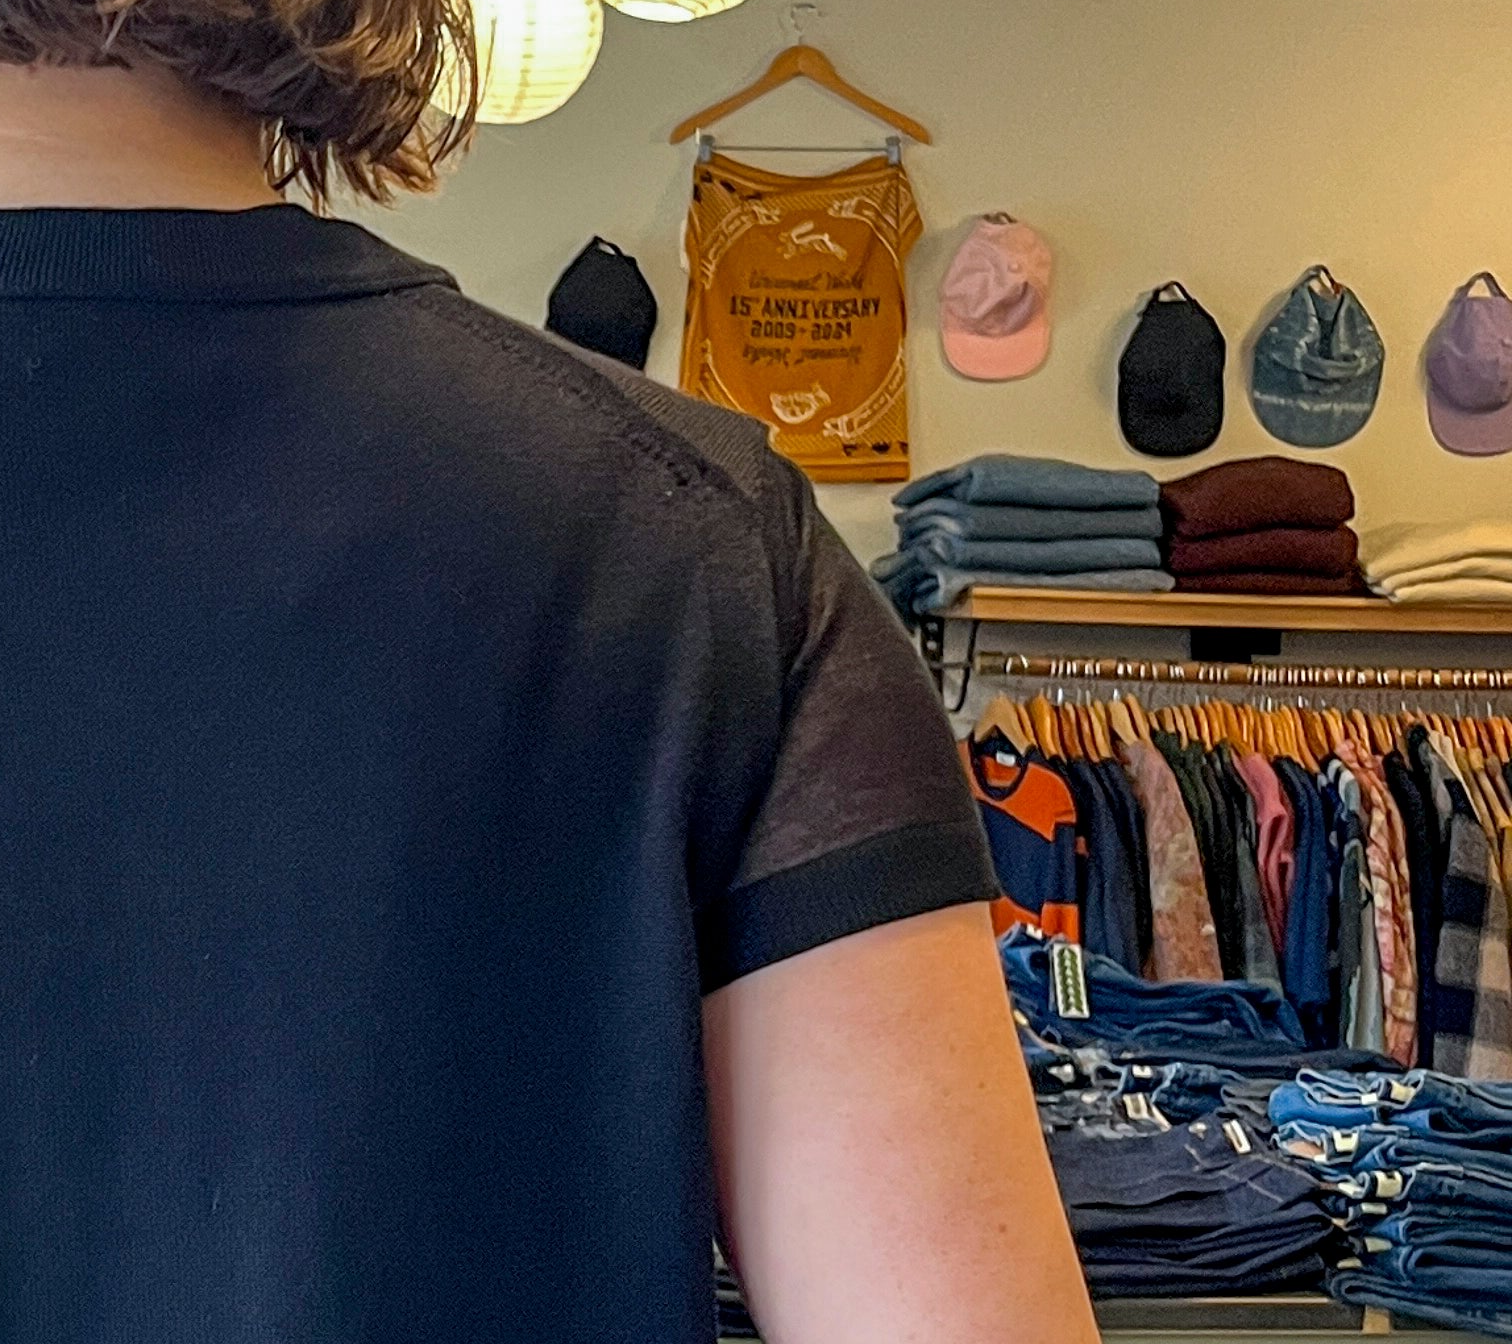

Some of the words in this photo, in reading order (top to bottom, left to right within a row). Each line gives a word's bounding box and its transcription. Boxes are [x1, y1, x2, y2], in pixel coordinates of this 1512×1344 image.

[761, 297, 881, 319] ANNIVERSARY
[751, 320, 796, 339] 2009
[811, 321, 852, 341] 2024
